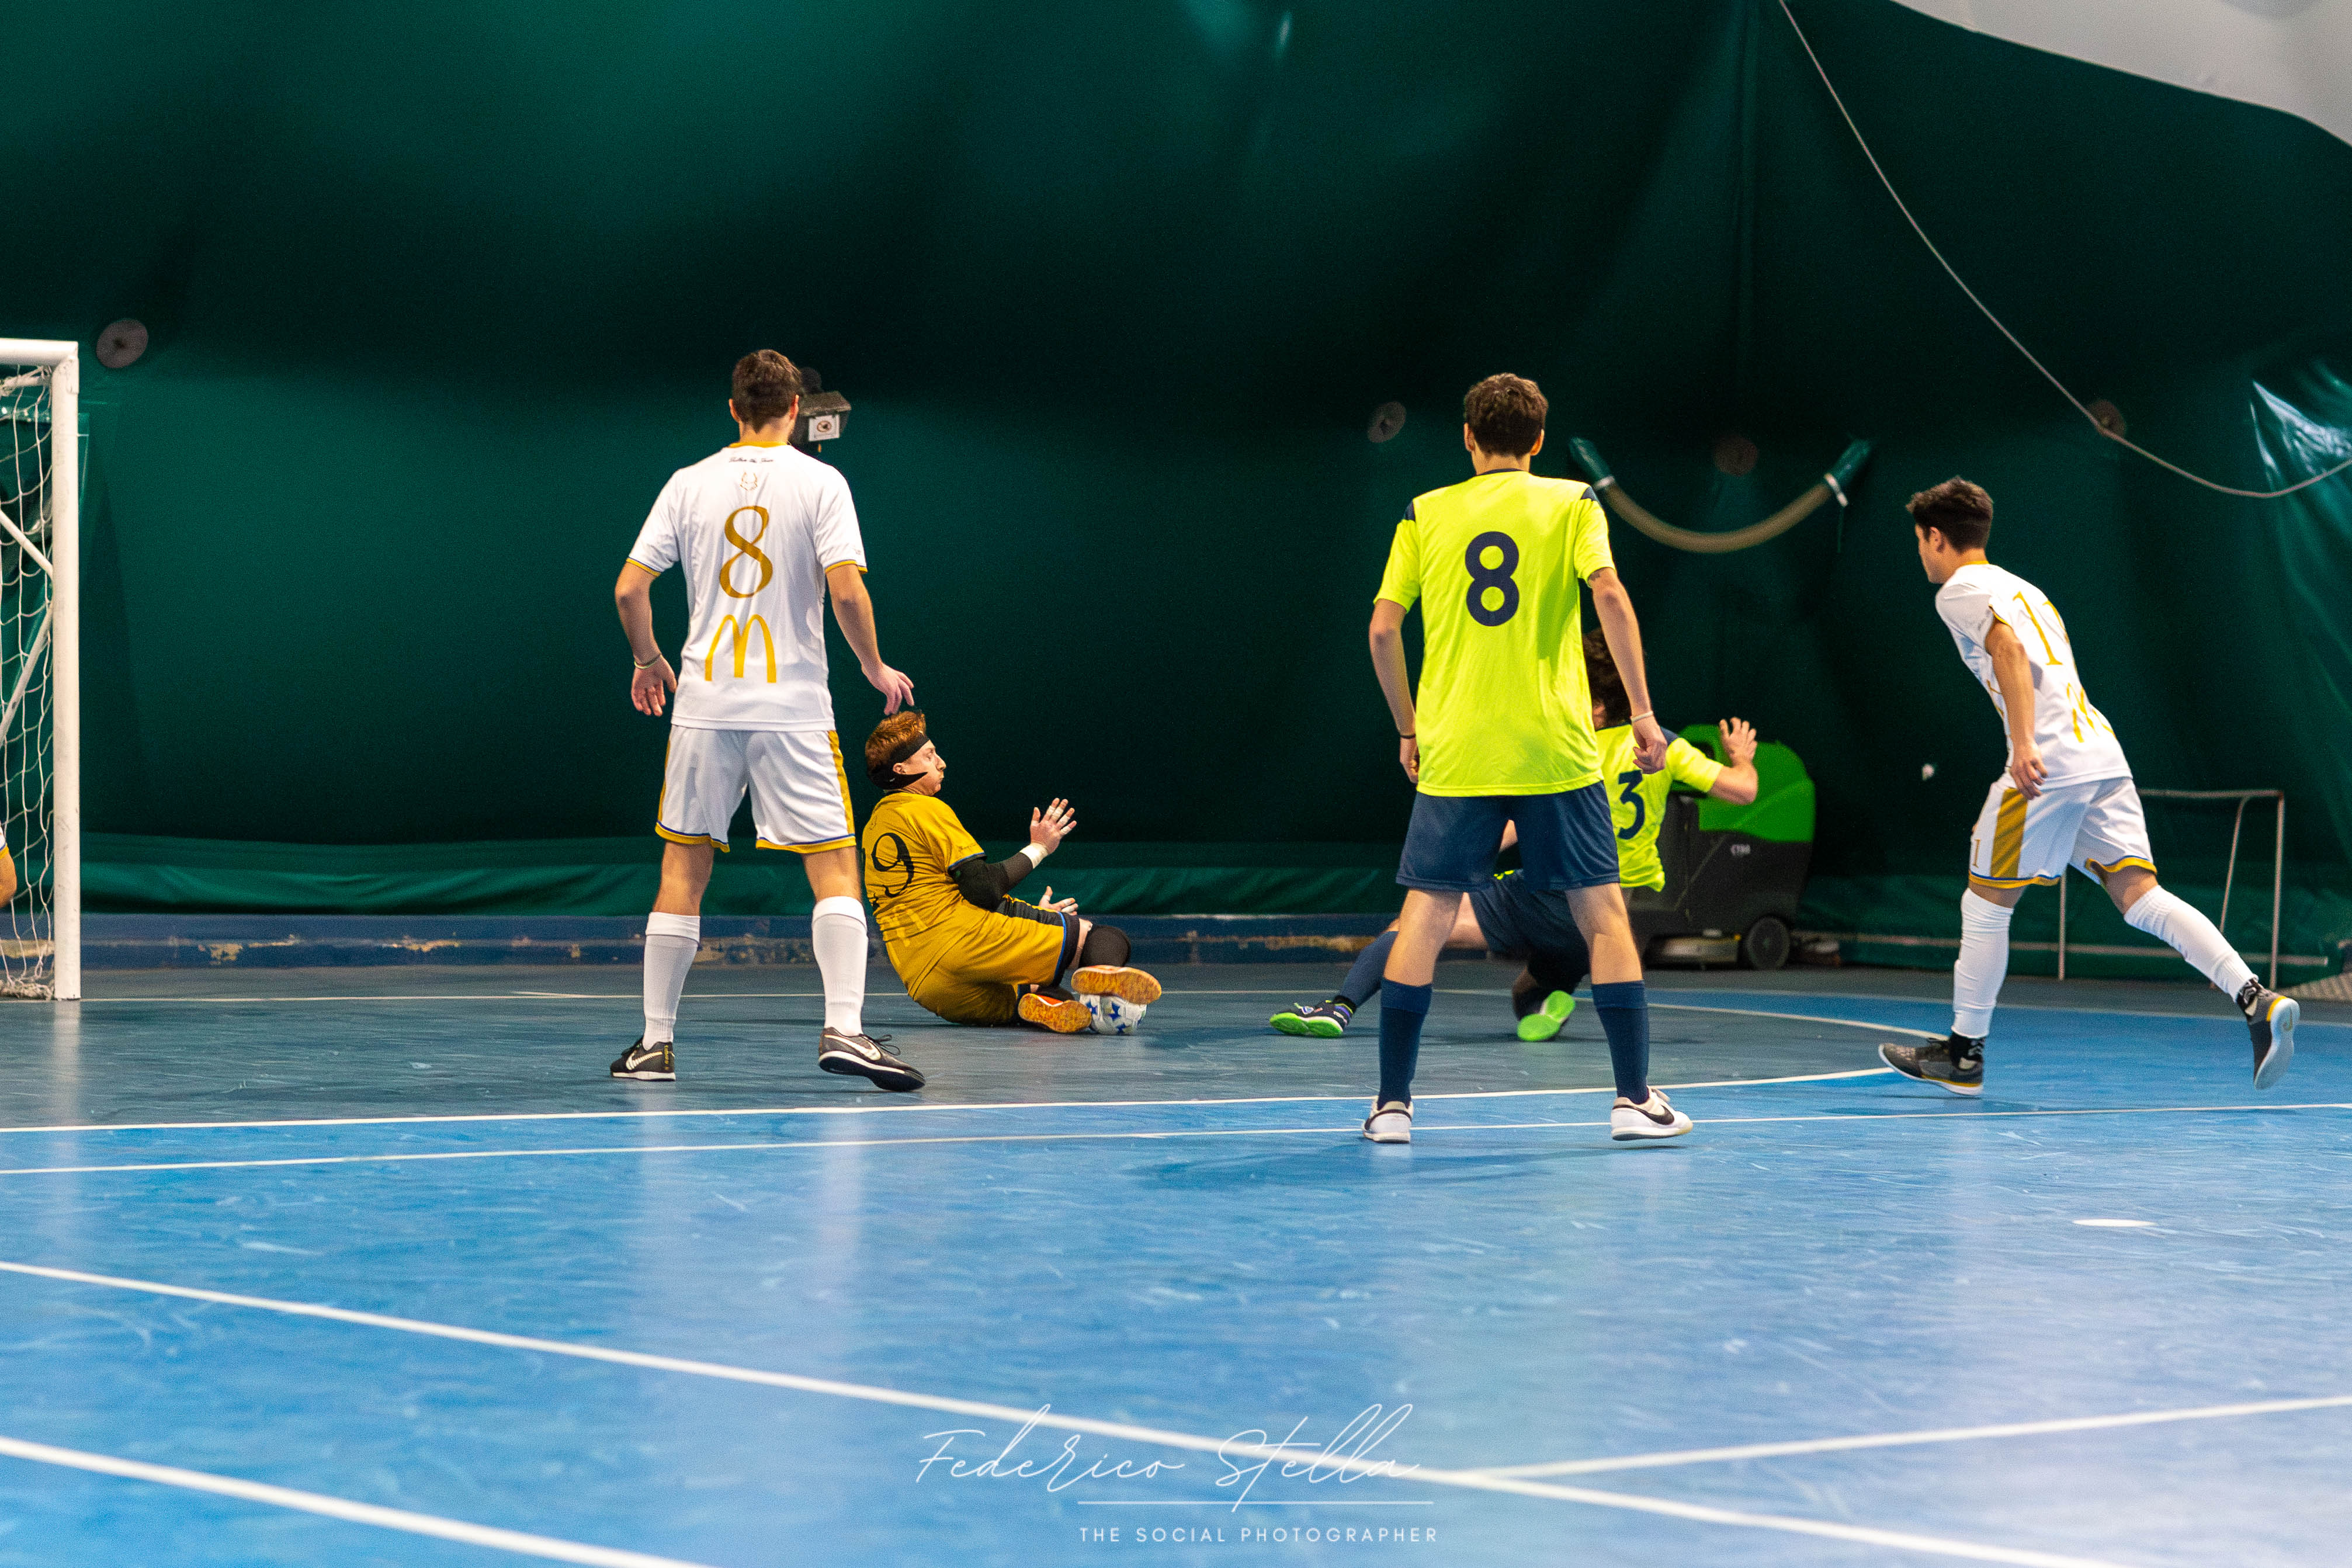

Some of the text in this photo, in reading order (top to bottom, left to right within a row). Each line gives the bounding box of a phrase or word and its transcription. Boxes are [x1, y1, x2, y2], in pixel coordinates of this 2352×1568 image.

[719, 505, 773, 598] 8
[1465, 531, 1520, 626] 8
[1618, 770, 1646, 840] 3
